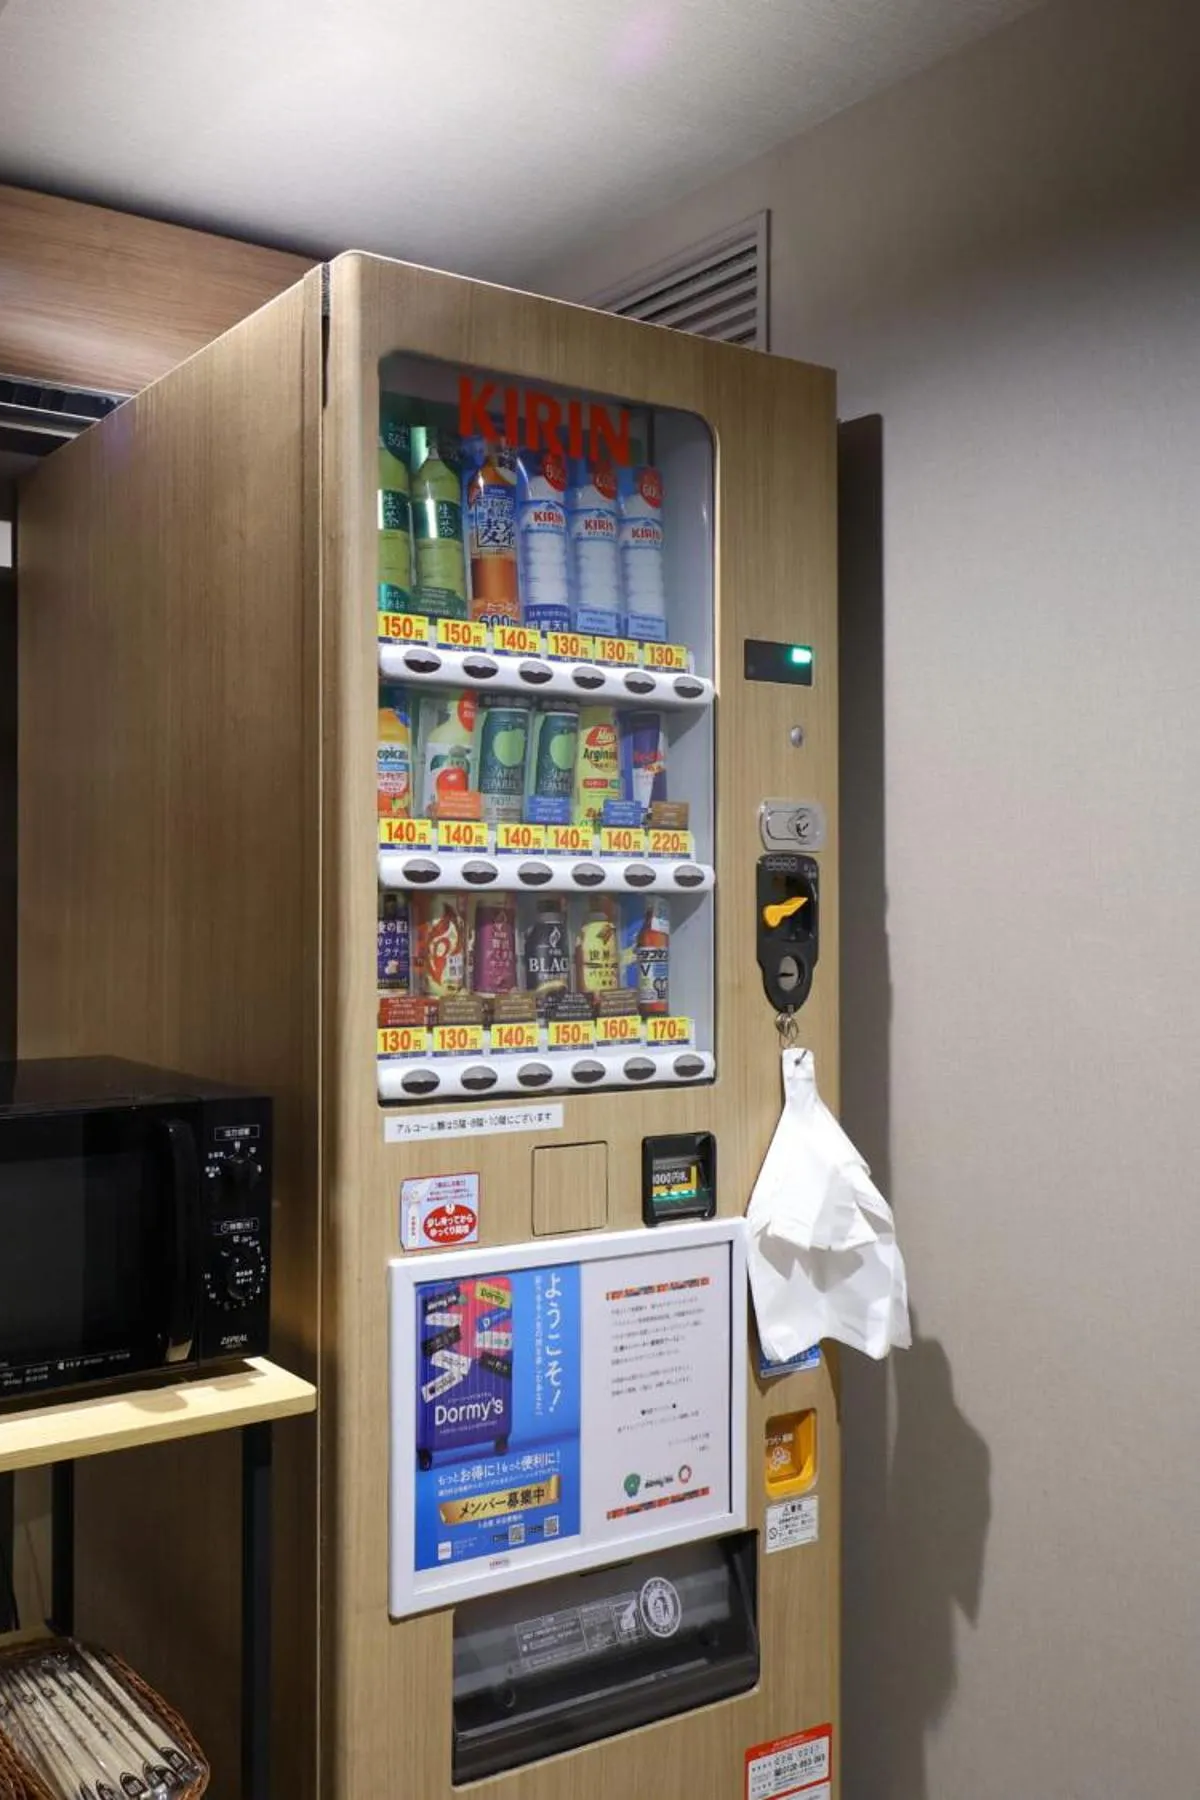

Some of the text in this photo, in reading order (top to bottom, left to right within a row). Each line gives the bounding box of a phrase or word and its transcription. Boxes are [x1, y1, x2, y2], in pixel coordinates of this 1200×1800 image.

[458, 375, 631, 467] KIRIN
[584, 519, 615, 532] KIRIN
[383, 615, 424, 640] 150円
[443, 623, 482, 646] 150円
[500, 629, 537, 652] 140円
[552, 635, 589, 657] 130円
[600, 639, 635, 662] 130円
[649, 646, 683, 667] 130円
[385, 821, 427, 843] 140円
[444, 824, 485, 846] 140円
[504, 827, 542, 847] 140円
[554, 829, 590, 849] 140円
[606, 831, 641, 850] 140円
[652, 834, 688, 852] 220円
[439, 1028, 478, 1051] 130円
[497, 1026, 535, 1047] 140円
[555, 1023, 590, 1044] 150円
[603, 1019, 637, 1039] 160円
[652, 1020, 686, 1039] 170円
[381, 1030, 422, 1052] 130円
[434, 1397, 504, 1426] Dormy's
[459, 1486, 545, 1519] メンバー募集中
